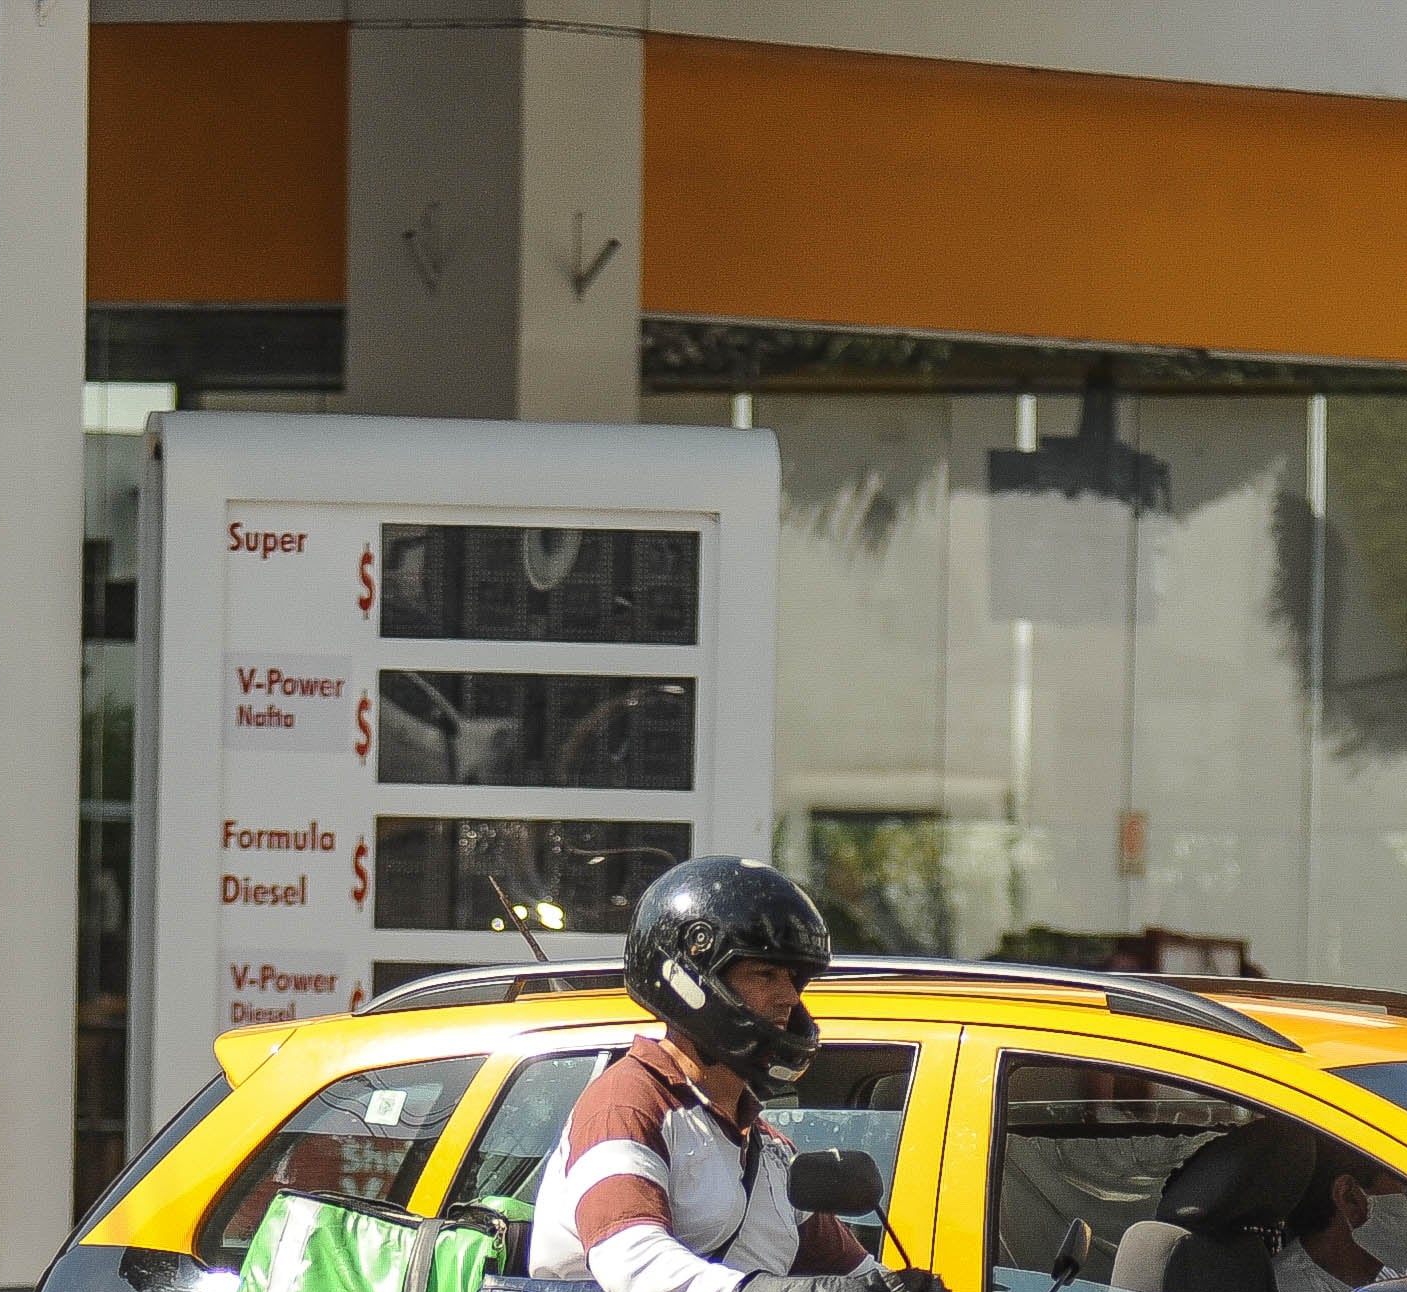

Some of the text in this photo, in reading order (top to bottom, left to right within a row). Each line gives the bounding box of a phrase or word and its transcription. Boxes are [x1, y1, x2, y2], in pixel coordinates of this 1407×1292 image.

[229, 522, 307, 560] Super
[357, 542, 375, 619] $
[238, 667, 345, 698] V-Power
[237, 704, 294, 730] Nafta
[354, 690, 372, 764] $
[222, 820, 336, 852] Formula
[352, 836, 368, 910] $
[221, 874, 307, 905] Diesel
[231, 964, 338, 995] V-Power
